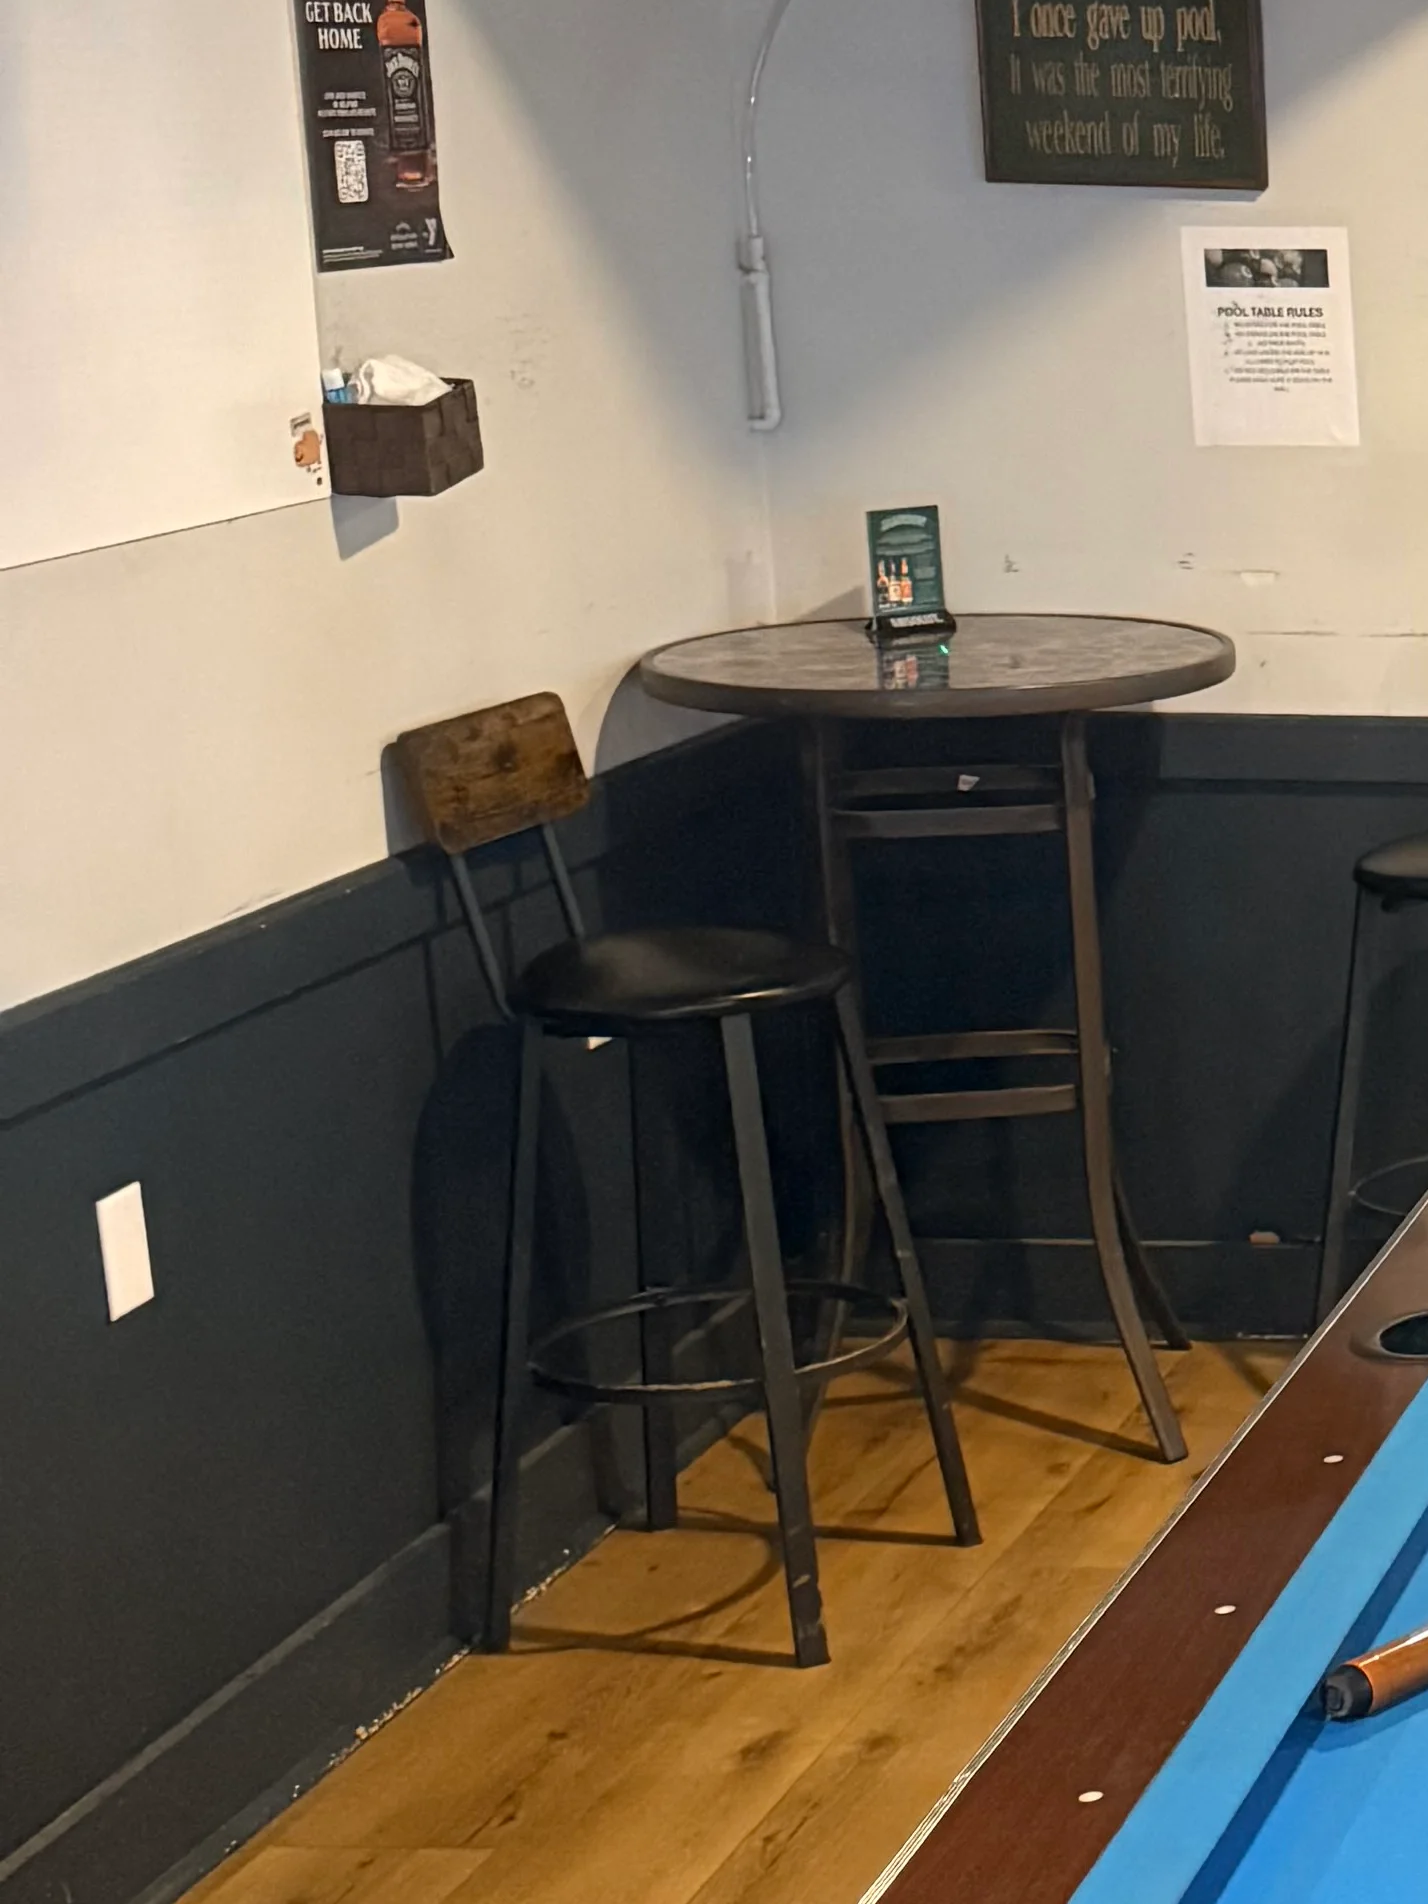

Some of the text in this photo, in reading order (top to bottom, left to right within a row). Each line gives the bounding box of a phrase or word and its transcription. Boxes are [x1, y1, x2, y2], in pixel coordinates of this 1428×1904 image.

[305, 1, 373, 24] GET BACK
[1030, 2, 1077, 39] once
[1086, 1, 1130, 51] gave
[1140, 5, 1165, 53] up
[318, 28, 363, 51] HOME
[1032, 59, 1067, 96] was
[1074, 52, 1100, 97] the
[1110, 59, 1151, 97] most
[1160, 54, 1234, 113] terrifying
[1025, 110, 1226, 168] weekend of my life.
[1251, 306, 1284, 318] TABLE
[1286, 306, 1324, 318] RULES
